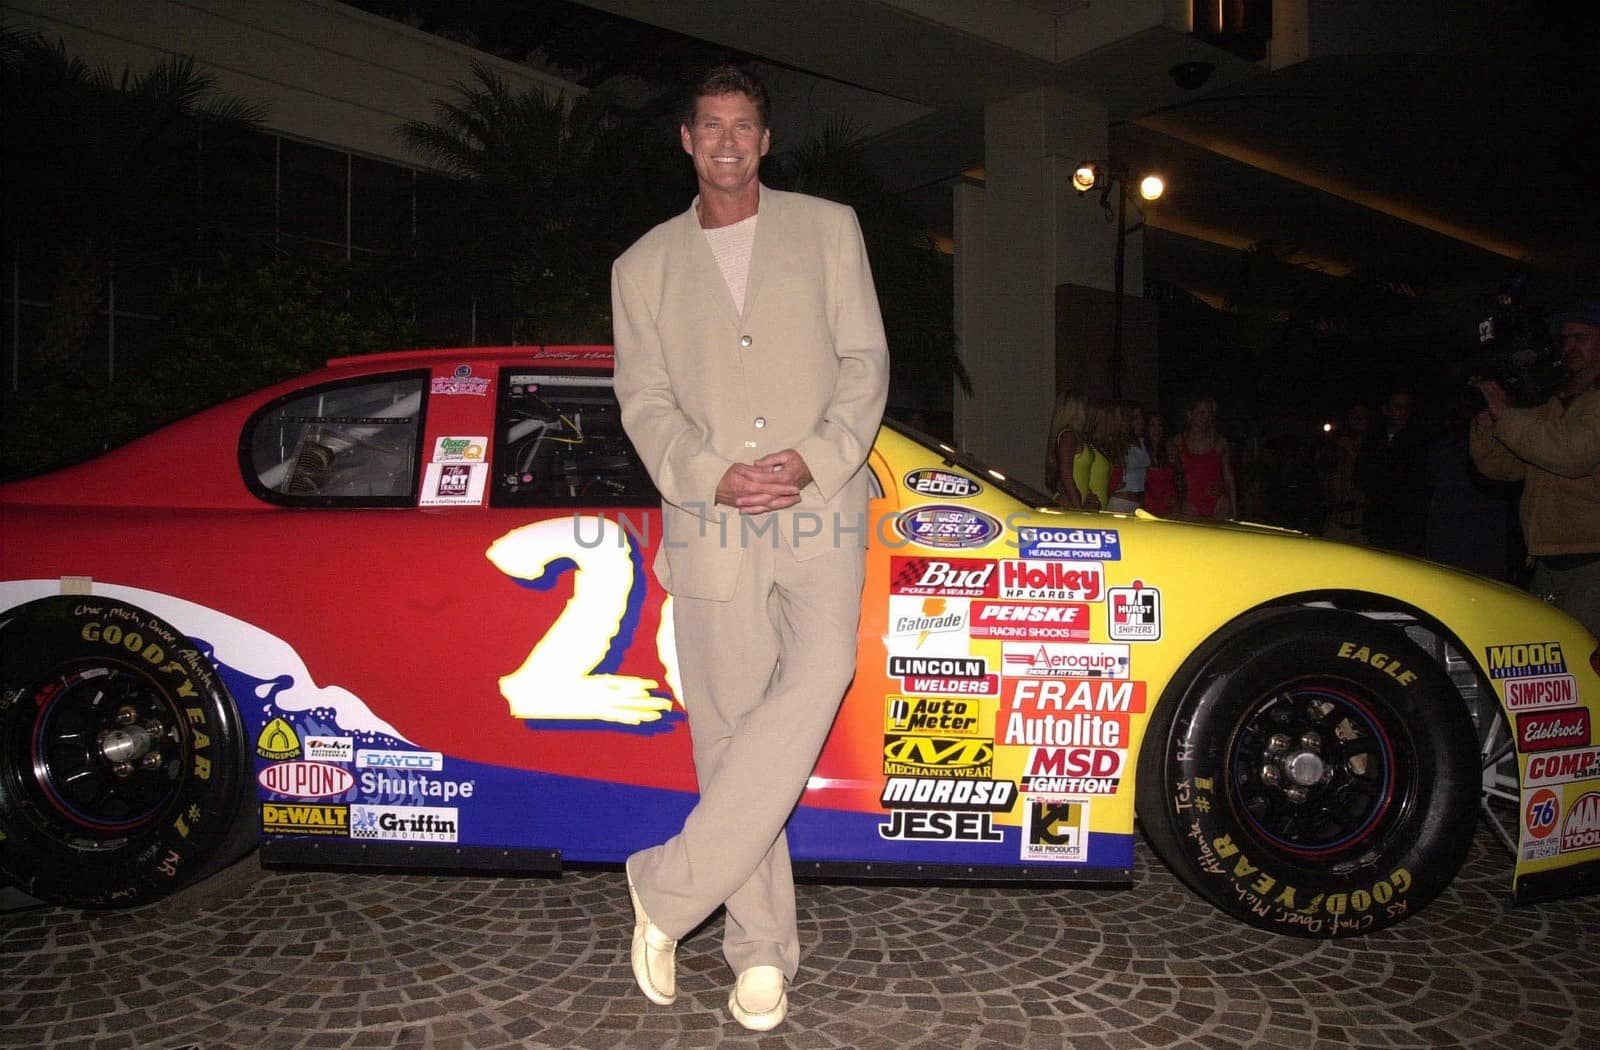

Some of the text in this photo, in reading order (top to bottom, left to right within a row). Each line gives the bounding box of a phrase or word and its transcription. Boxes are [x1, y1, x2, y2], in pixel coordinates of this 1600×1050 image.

[441, 474, 468, 484] PET
[916, 479, 969, 495] 2000
[935, 473, 970, 486] NASCAR
[1020, 528, 1118, 548] Goody's
[1029, 549, 1112, 559] HEADACHE POWDERS
[915, 562, 994, 588] Bud
[1004, 561, 1100, 599] Holley
[1006, 590, 1075, 600] HP CARBS
[980, 604, 1080, 624] PENSKE
[1118, 605, 1152, 614] HURST
[896, 612, 961, 632] Gatorade
[1118, 625, 1152, 634] SHIFTERS
[989, 626, 1070, 639] RACING SHOCKS
[1032, 645, 1116, 670] Aeroquip
[1337, 641, 1419, 687] EAGLE
[1490, 643, 1562, 668] MOOG
[894, 660, 980, 676] LINCOLN
[1494, 664, 1563, 678] CHASSIS PARTS
[914, 680, 990, 693] WELDERS
[1012, 681, 1133, 712] FRAM
[1510, 680, 1571, 706] SIMPSON
[81, 622, 212, 781] GOODYEAR
[914, 699, 968, 714] Auto
[910, 714, 976, 730] Meter
[1005, 712, 1120, 747] Autolite
[1524, 718, 1584, 742] Edelbrock
[256, 748, 302, 760] KLINGSPOR
[366, 754, 433, 768] DAYCO
[1030, 748, 1120, 777] MSD
[885, 764, 992, 778] MECHANIX WEAR
[1529, 752, 1596, 779] COMP
[360, 772, 473, 802] Shurtape
[882, 780, 1012, 806] MOROSO
[1028, 778, 1113, 793] IGNITION
[380, 811, 456, 833] Griffin
[1530, 798, 1556, 830] 76
[880, 812, 1002, 840] JESEL
[382, 832, 456, 841] RADIATOR
[1214, 834, 1412, 916] GOODYEAR
